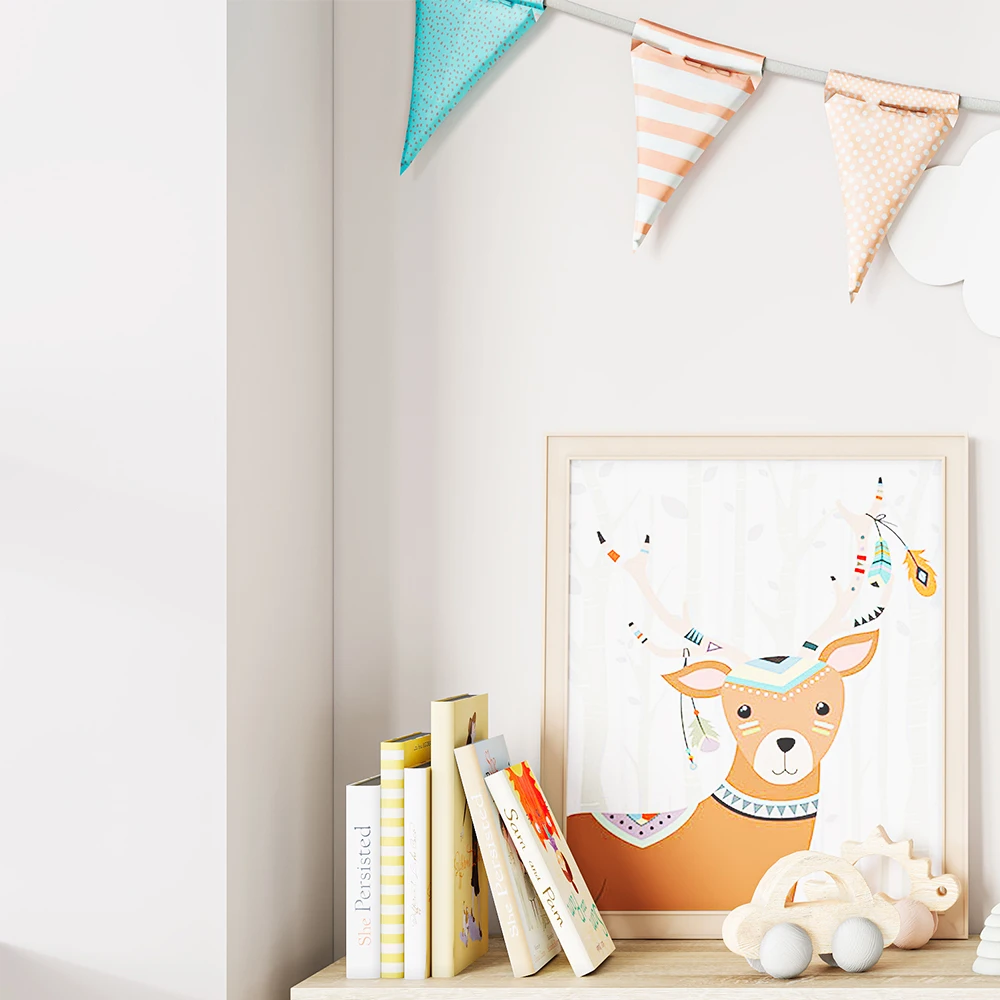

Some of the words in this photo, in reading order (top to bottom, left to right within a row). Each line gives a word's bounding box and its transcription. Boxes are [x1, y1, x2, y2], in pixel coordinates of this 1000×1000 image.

[354, 825, 372, 911] Persisted
[471, 794, 508, 896] Persisted
[503, 807, 526, 851] Sam
[528, 860, 541, 881] and
[542, 886, 564, 928] Pam
[358, 917, 372, 946] She
[504, 902, 519, 938] She
